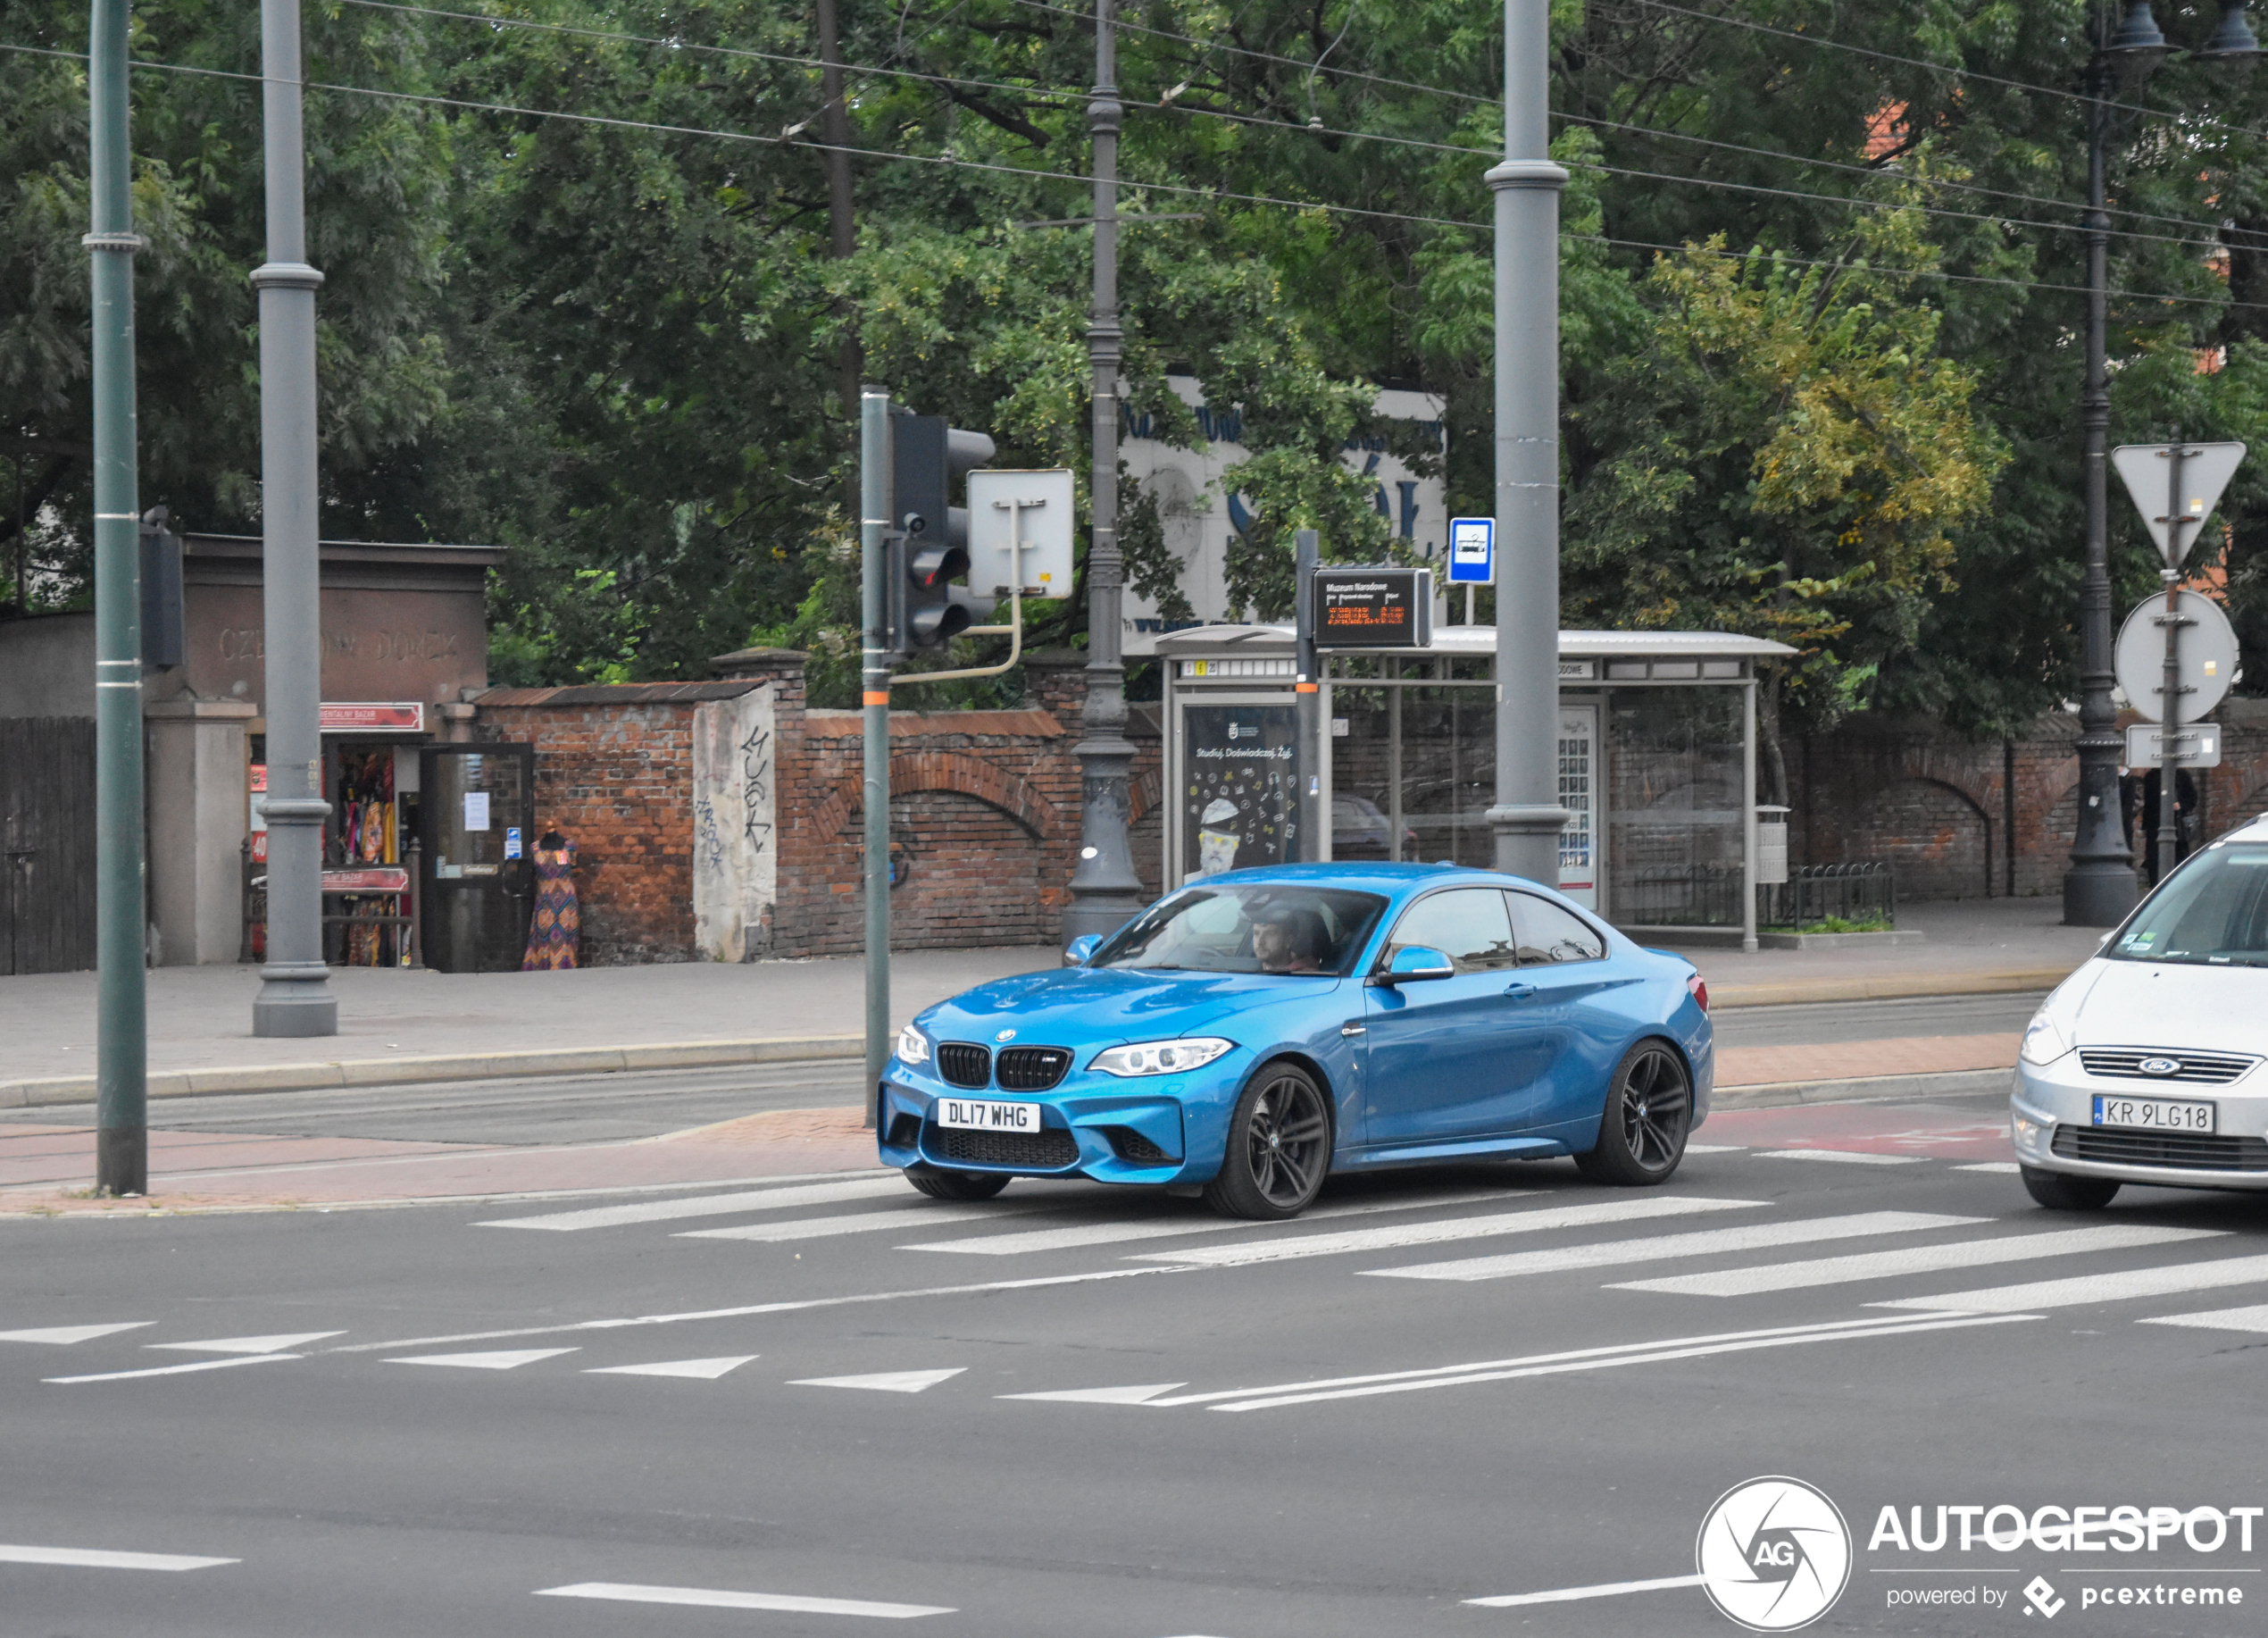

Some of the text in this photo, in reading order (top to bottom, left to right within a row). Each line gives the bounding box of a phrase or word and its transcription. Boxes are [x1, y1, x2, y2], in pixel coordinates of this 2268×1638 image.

[1326, 582, 1388, 592] Muzeum Narodowe
[2148, 1061, 2167, 1071] Ford
[949, 1103, 1028, 1127] DL17 WHG
[2107, 1100, 2207, 1128] KR 9LG18
